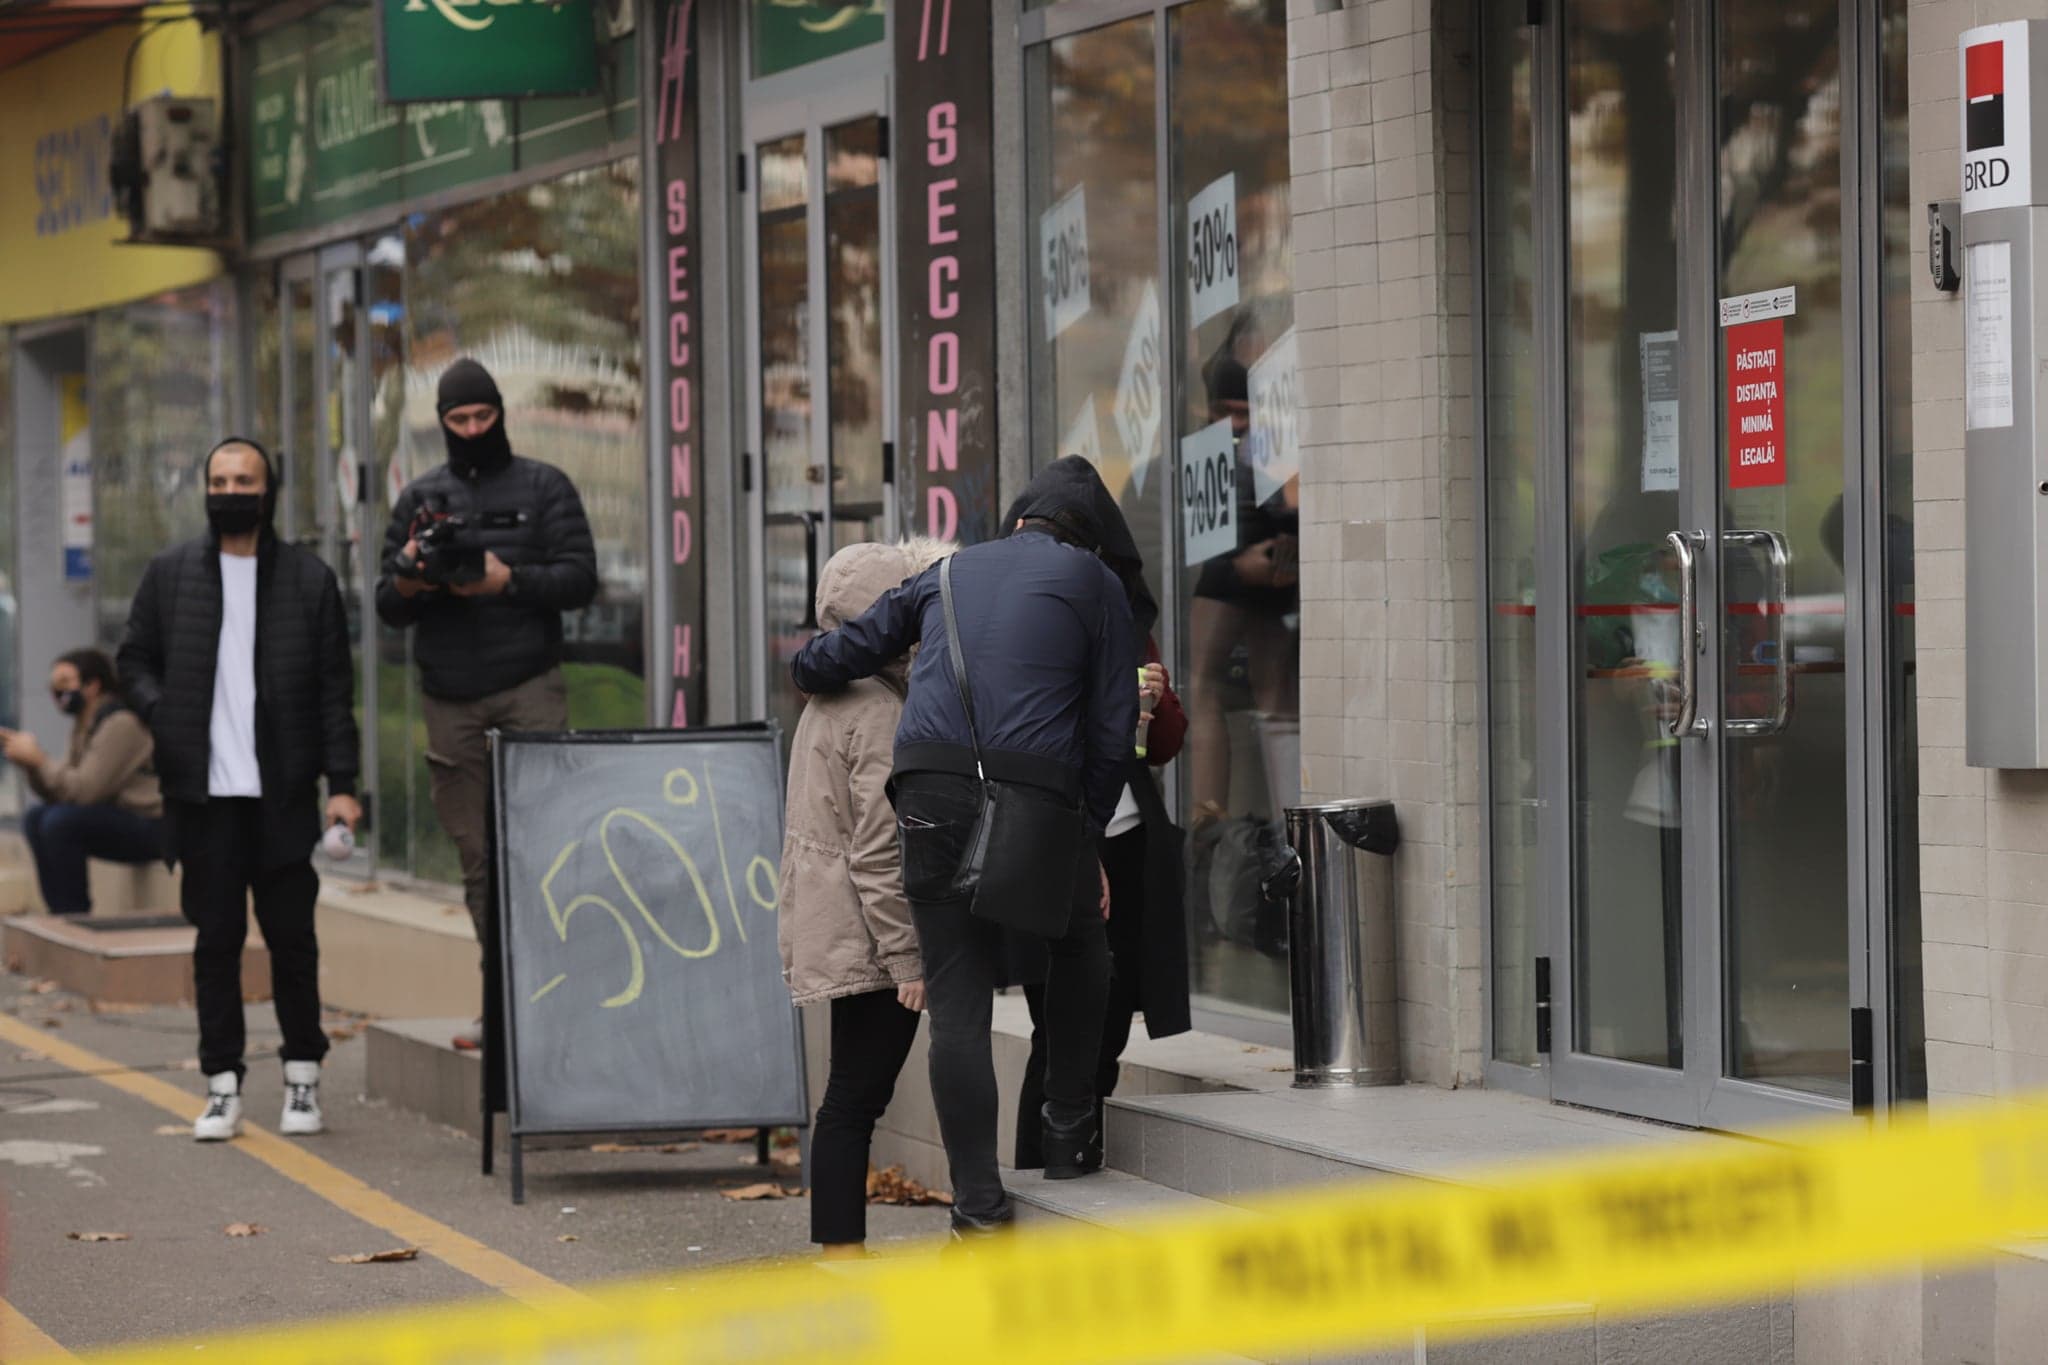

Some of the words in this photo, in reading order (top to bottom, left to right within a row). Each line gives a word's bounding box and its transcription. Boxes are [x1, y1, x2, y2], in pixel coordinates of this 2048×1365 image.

[1965, 158, 2010, 192] BRD
[1188, 203, 1234, 293] -50%
[926, 101, 958, 541] SECOND
[667, 178, 692, 565] SECOND
[1736, 348, 1776, 373] PĂSTRAȚI
[1736, 382, 1777, 405] DISTANȚA
[1741, 409, 1773, 434] MINIMĂ
[1740, 441, 1775, 466] LEGALĂ!
[530, 760, 779, 1008] -50%
